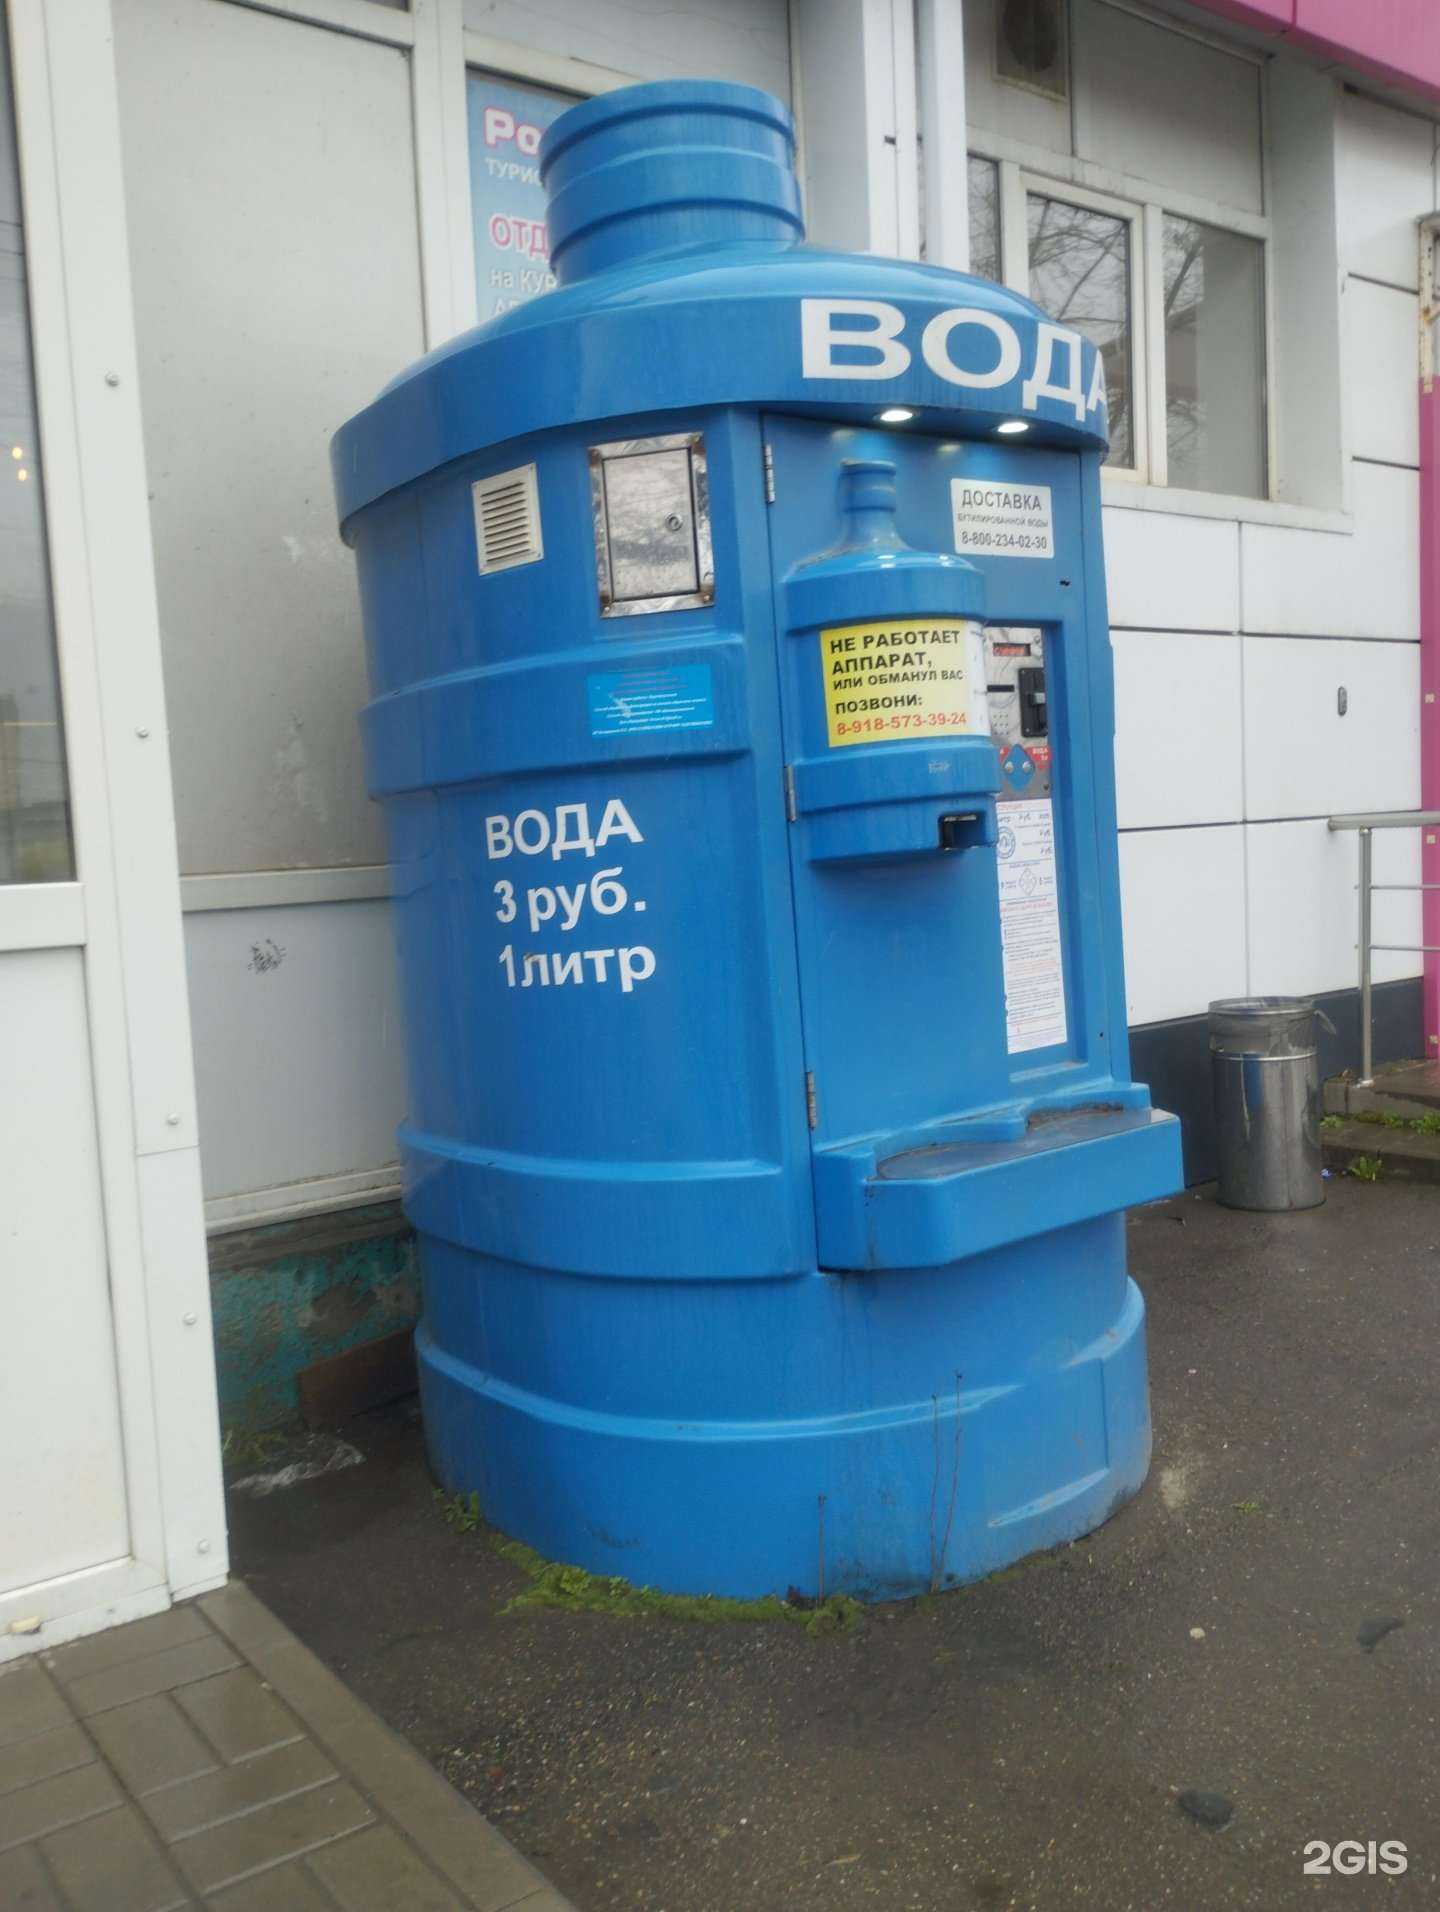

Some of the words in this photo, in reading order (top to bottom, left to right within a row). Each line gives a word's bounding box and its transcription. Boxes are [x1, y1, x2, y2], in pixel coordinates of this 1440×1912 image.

[801, 298, 1107, 421] ВОДА
[961, 489, 1043, 511] ДОСТАВКА
[961, 531, 1047, 549] 8-800-234-02-30
[830, 636, 856, 654] НЕ
[863, 630, 960, 650] РАБОТАЕТ
[832, 652, 933, 675] АППАРАТ,
[833, 677, 863, 691] ИЛИ
[868, 671, 937, 687] ОБМАНУЛ
[941, 669, 964, 682] ВАС
[835, 695, 923, 715] ПОЗВОНИ:
[837, 712, 967, 736] 8-918-573-39-24
[485, 799, 645, 861] ВОДА
[493, 880, 517, 924] 3
[527, 866, 647, 933] руб.
